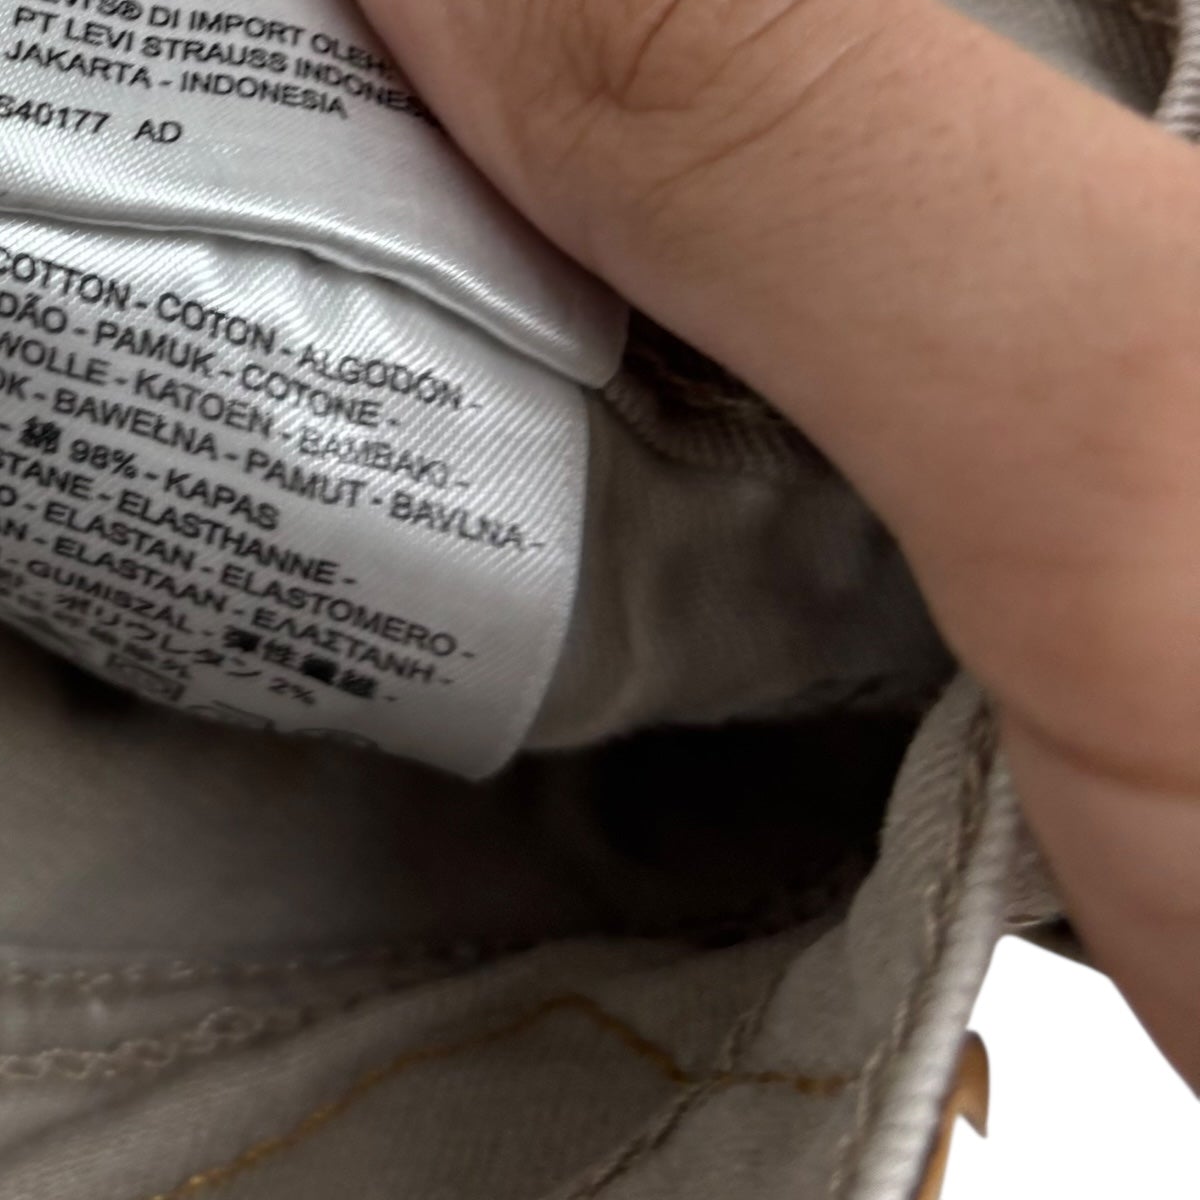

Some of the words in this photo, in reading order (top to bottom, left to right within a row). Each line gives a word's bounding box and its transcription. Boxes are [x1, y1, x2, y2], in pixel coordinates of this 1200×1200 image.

[13, 6, 62, 34] PT
[64, 17, 134, 52] LEVI
[142, 31, 290, 75] STRAUSS
[147, 3, 180, 28] DI
[188, 6, 306, 47] IMPORT
[4, 39, 153, 89] JAKARTA
[180, 71, 350, 120] INDONESIA
[132, 117, 183, 144] AD
[156, 290, 277, 354] COTON
[94, 320, 215, 378] PAMUK
[241, 362, 384, 429] COTONE
[134, 368, 274, 438] KATOEN
[69, 437, 138, 480] 98%
[164, 472, 282, 531] KAPAS
[244, 447, 369, 508] PAMUT
[52, 534, 229, 615] ELASTAAN
[116, 488, 341, 586] ELASTHANNE
[44, 500, 197, 573] ELASTAN
[219, 562, 459, 660] ELASTOMERO
